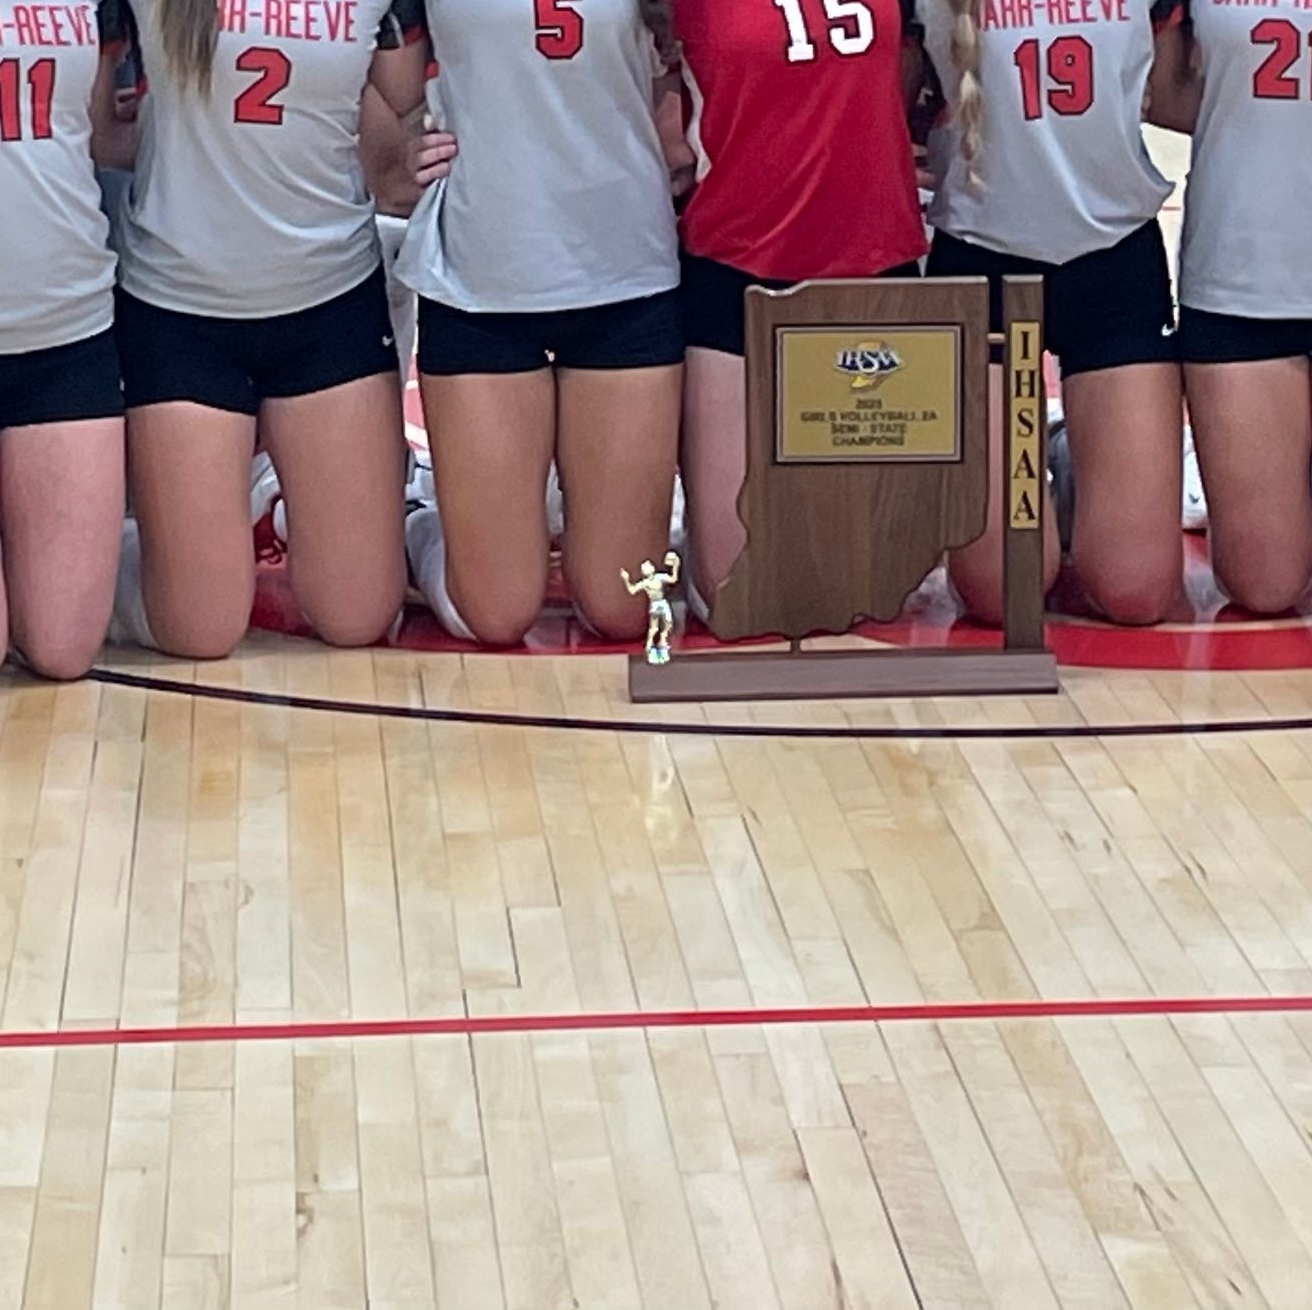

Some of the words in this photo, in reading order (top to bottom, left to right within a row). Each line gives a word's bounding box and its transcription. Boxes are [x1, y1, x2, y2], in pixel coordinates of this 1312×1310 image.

[234, 46, 292, 125] 2
[1014, 34, 1094, 121] 19
[1013, 331, 1036, 521] IHSAA
